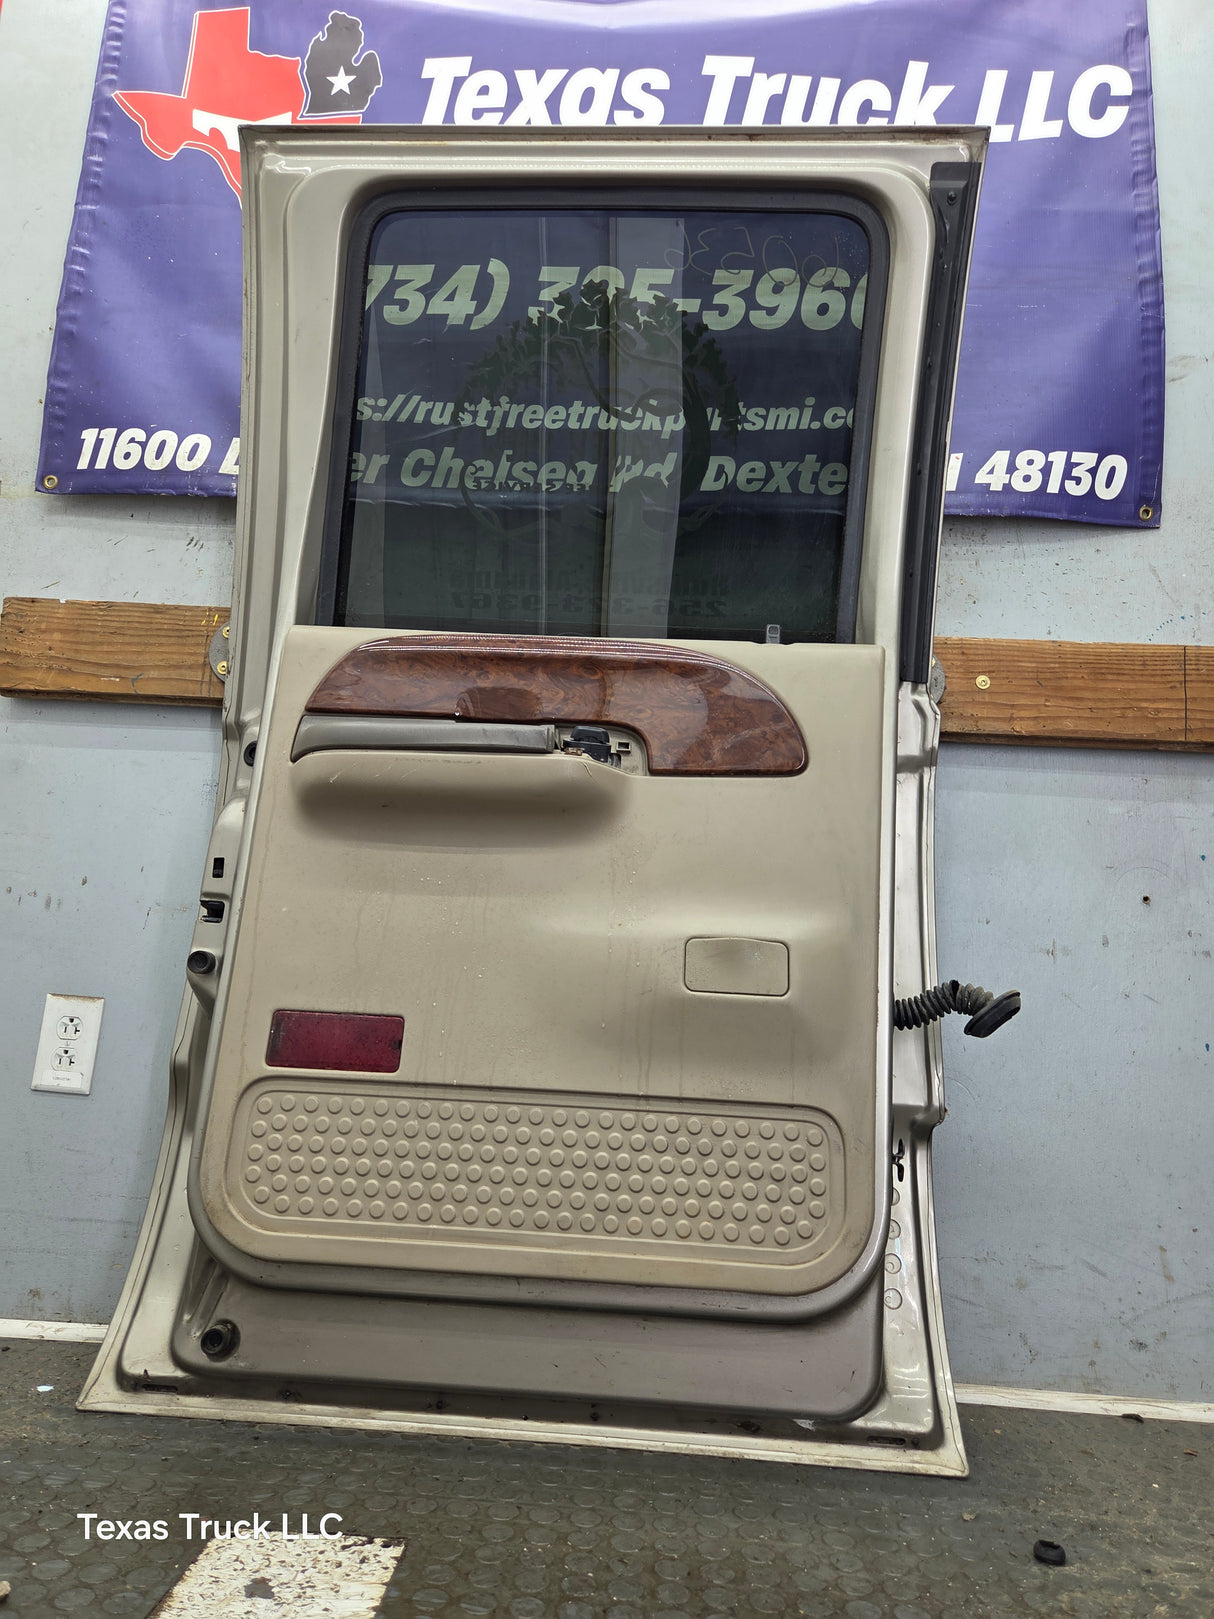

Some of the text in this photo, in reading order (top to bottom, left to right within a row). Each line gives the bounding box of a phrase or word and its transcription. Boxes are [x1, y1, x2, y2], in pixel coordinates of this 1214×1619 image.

[421, 55, 1132, 142] Texas Truck LLC
[76, 428, 212, 471] 11600
[974, 450, 1128, 500] 48130
